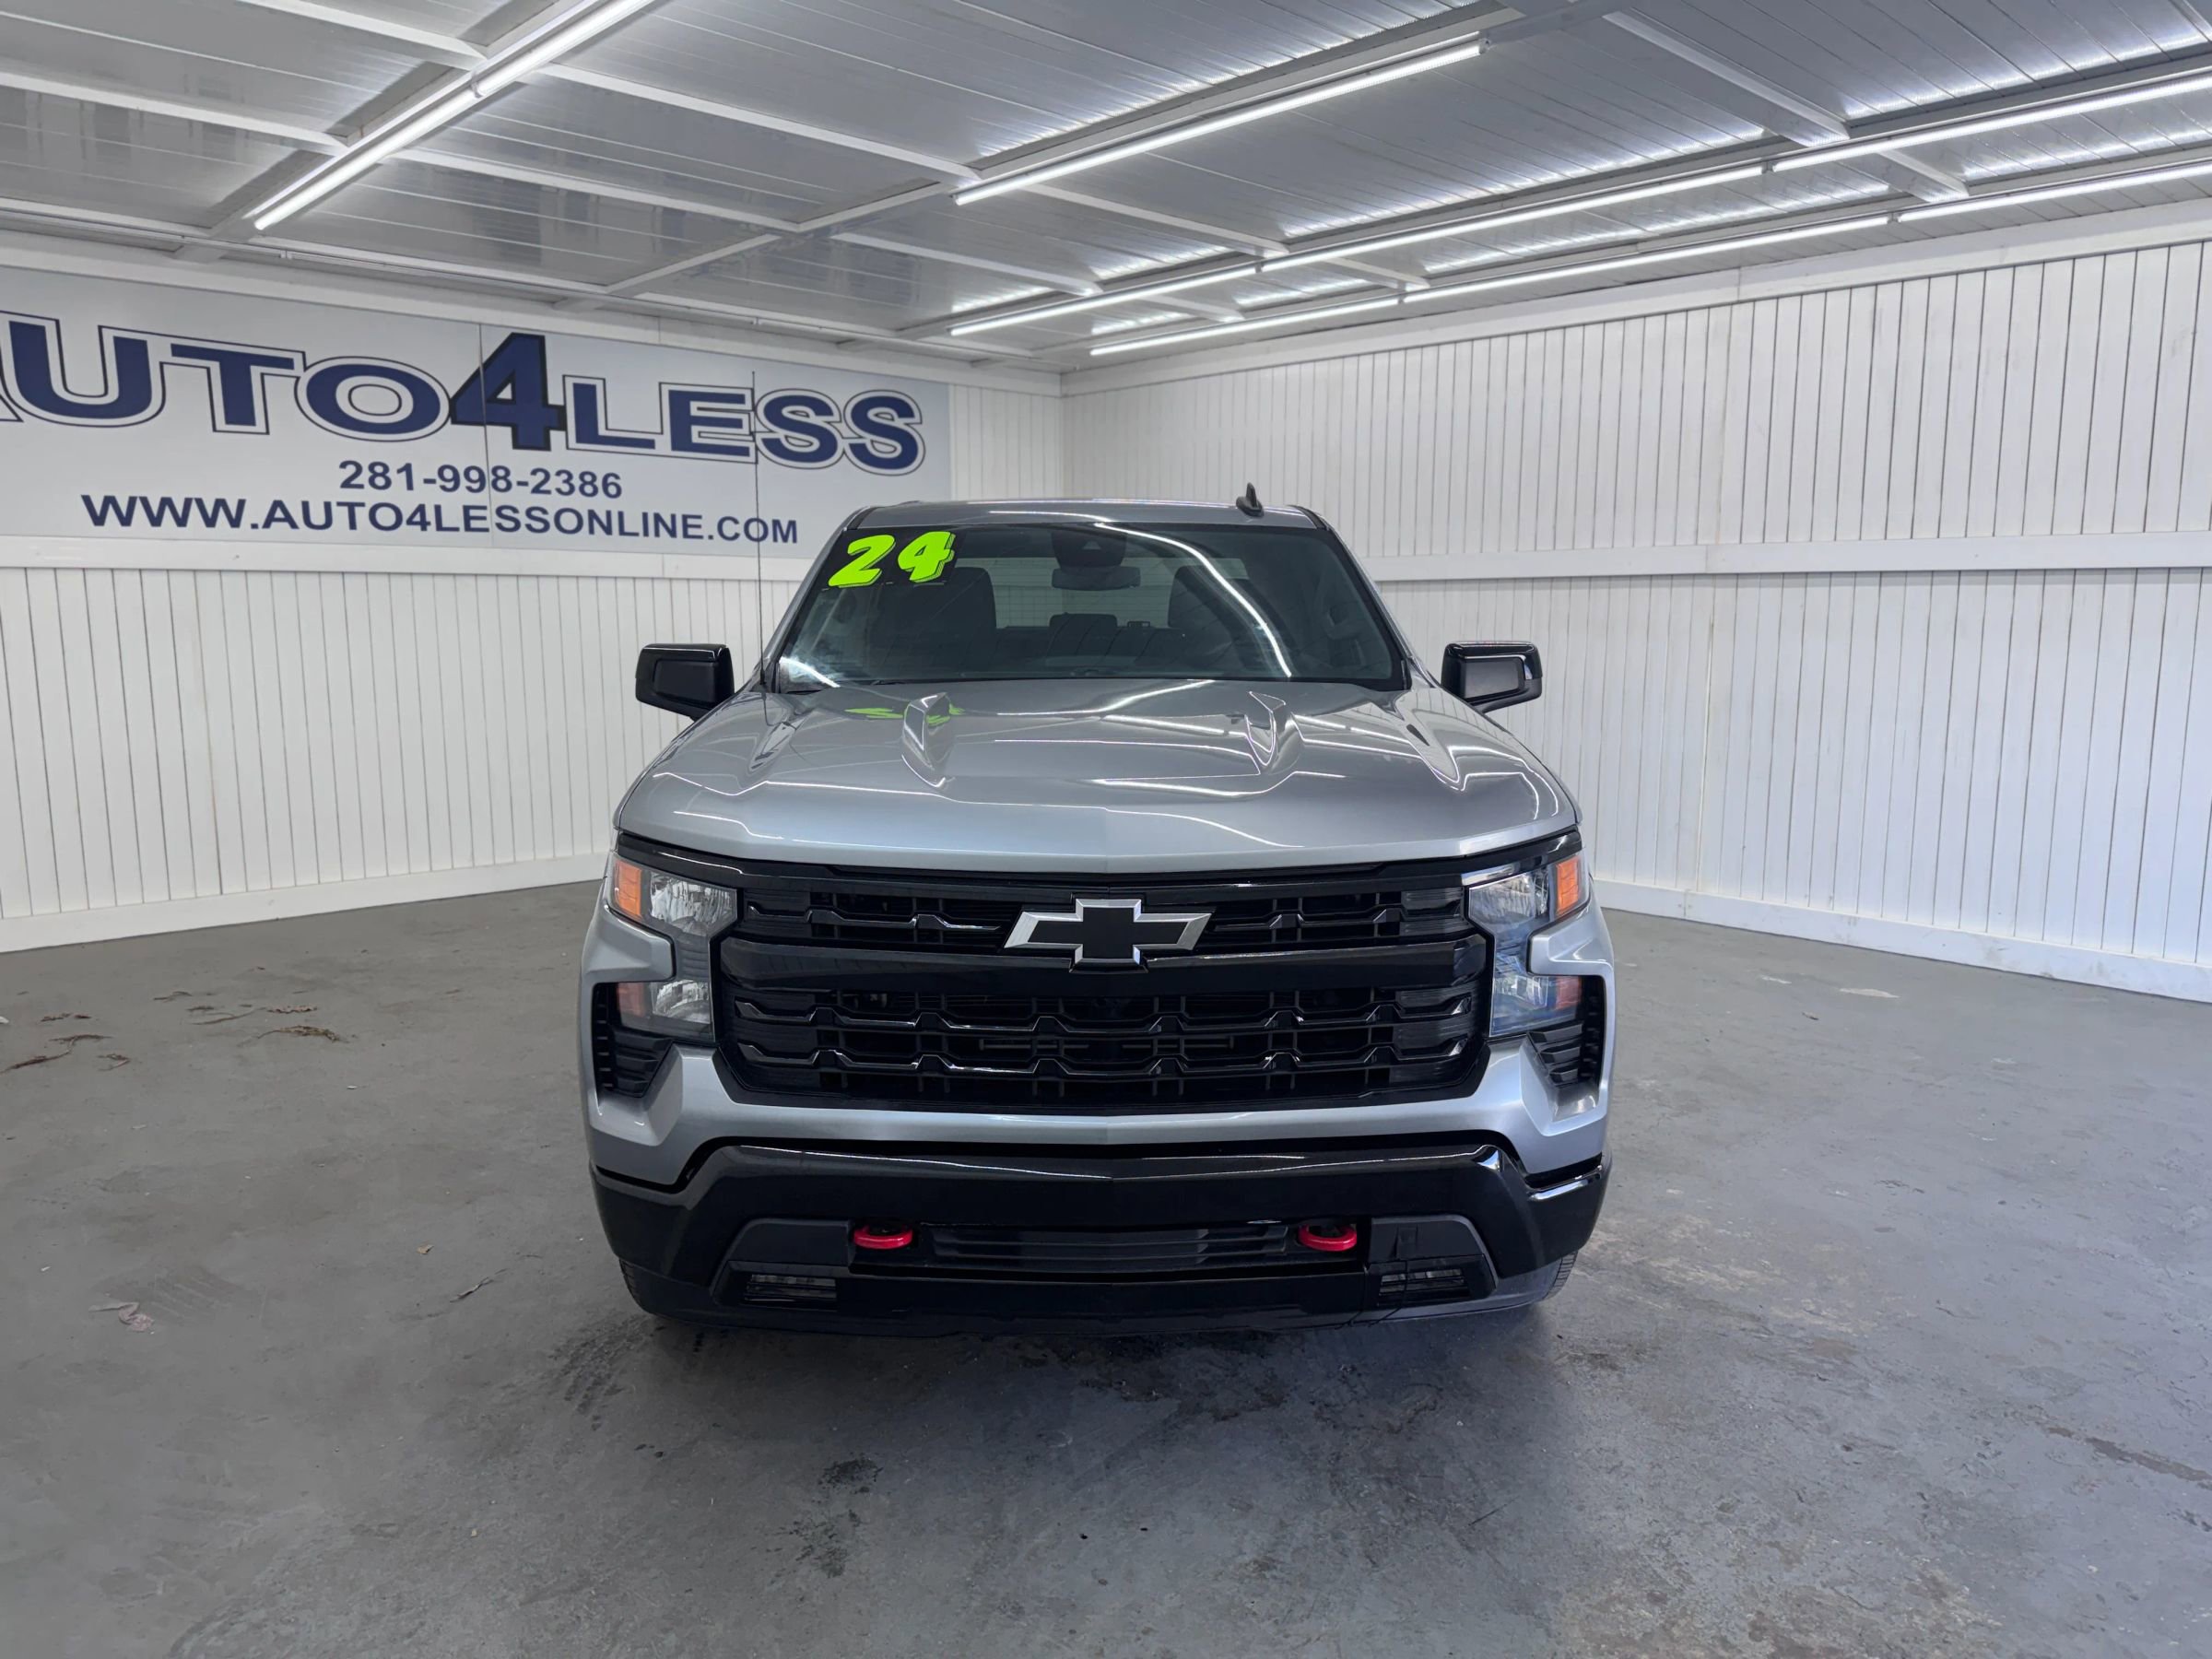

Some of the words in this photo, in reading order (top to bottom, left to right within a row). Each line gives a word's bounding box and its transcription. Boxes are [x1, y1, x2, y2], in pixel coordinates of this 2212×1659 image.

[0, 311, 925, 476] UTO4LESS
[339, 459, 622, 499] 281-998-2386
[81, 494, 797, 545] WWW.AUTO4LESSONLINE.COM
[828, 531, 956, 588] 24
